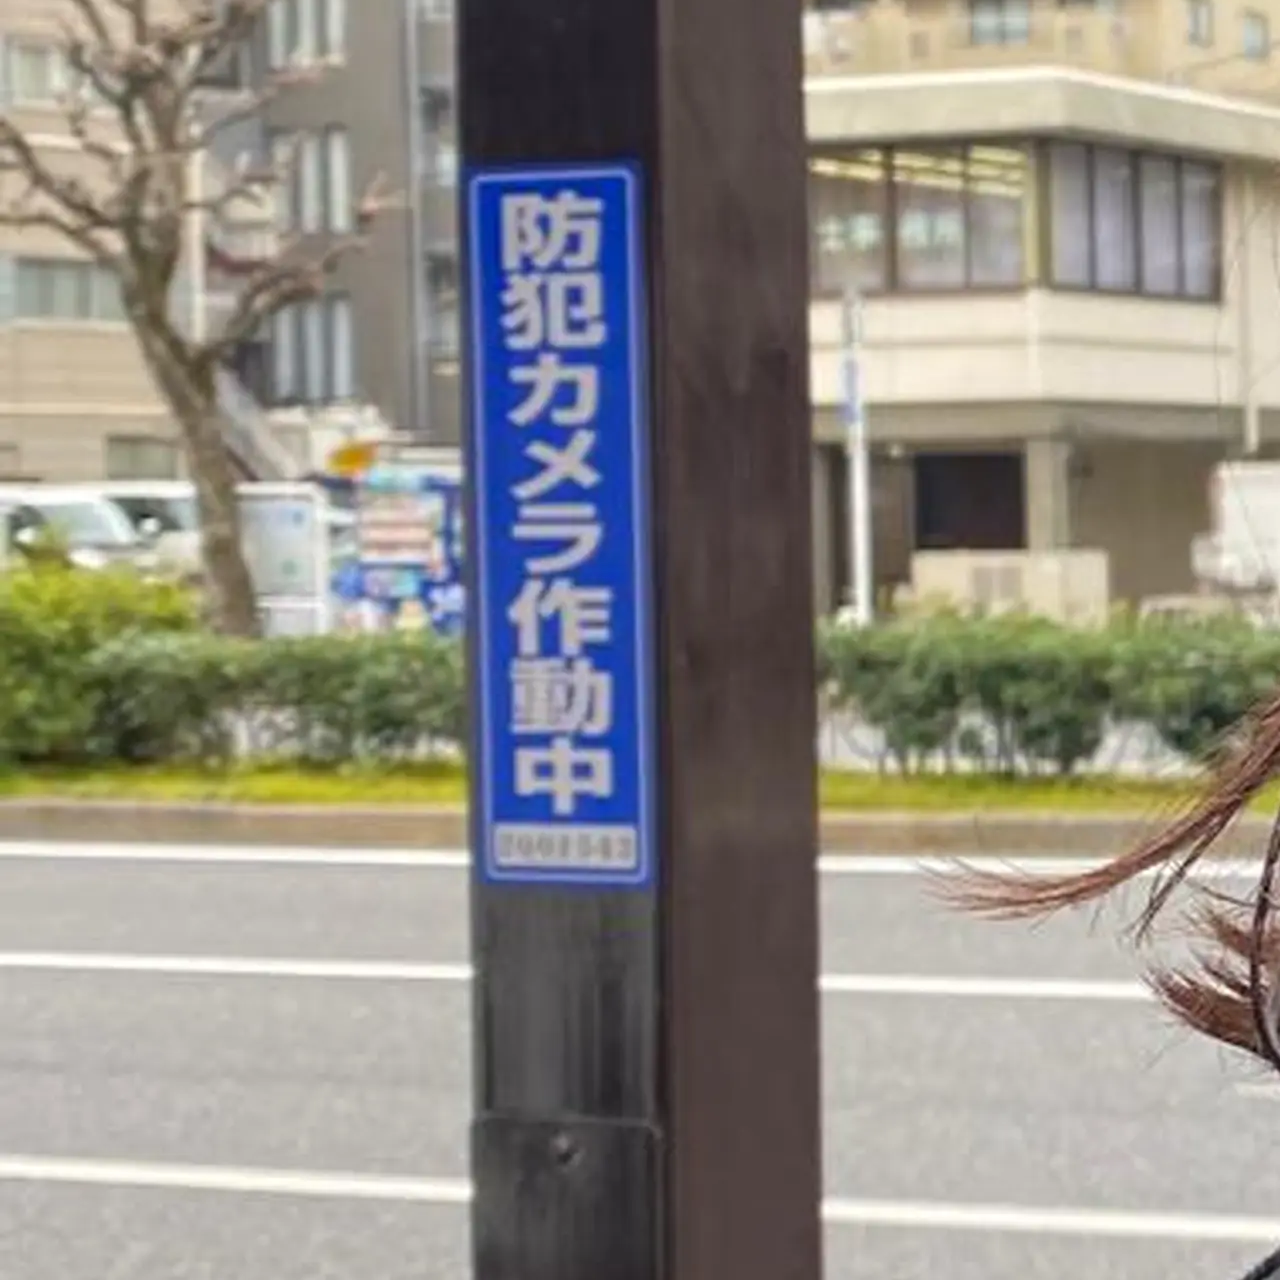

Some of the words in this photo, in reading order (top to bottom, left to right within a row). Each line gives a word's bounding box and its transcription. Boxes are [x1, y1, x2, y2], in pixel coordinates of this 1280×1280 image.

[500, 190, 614, 815] 防犯カメラ作動中
